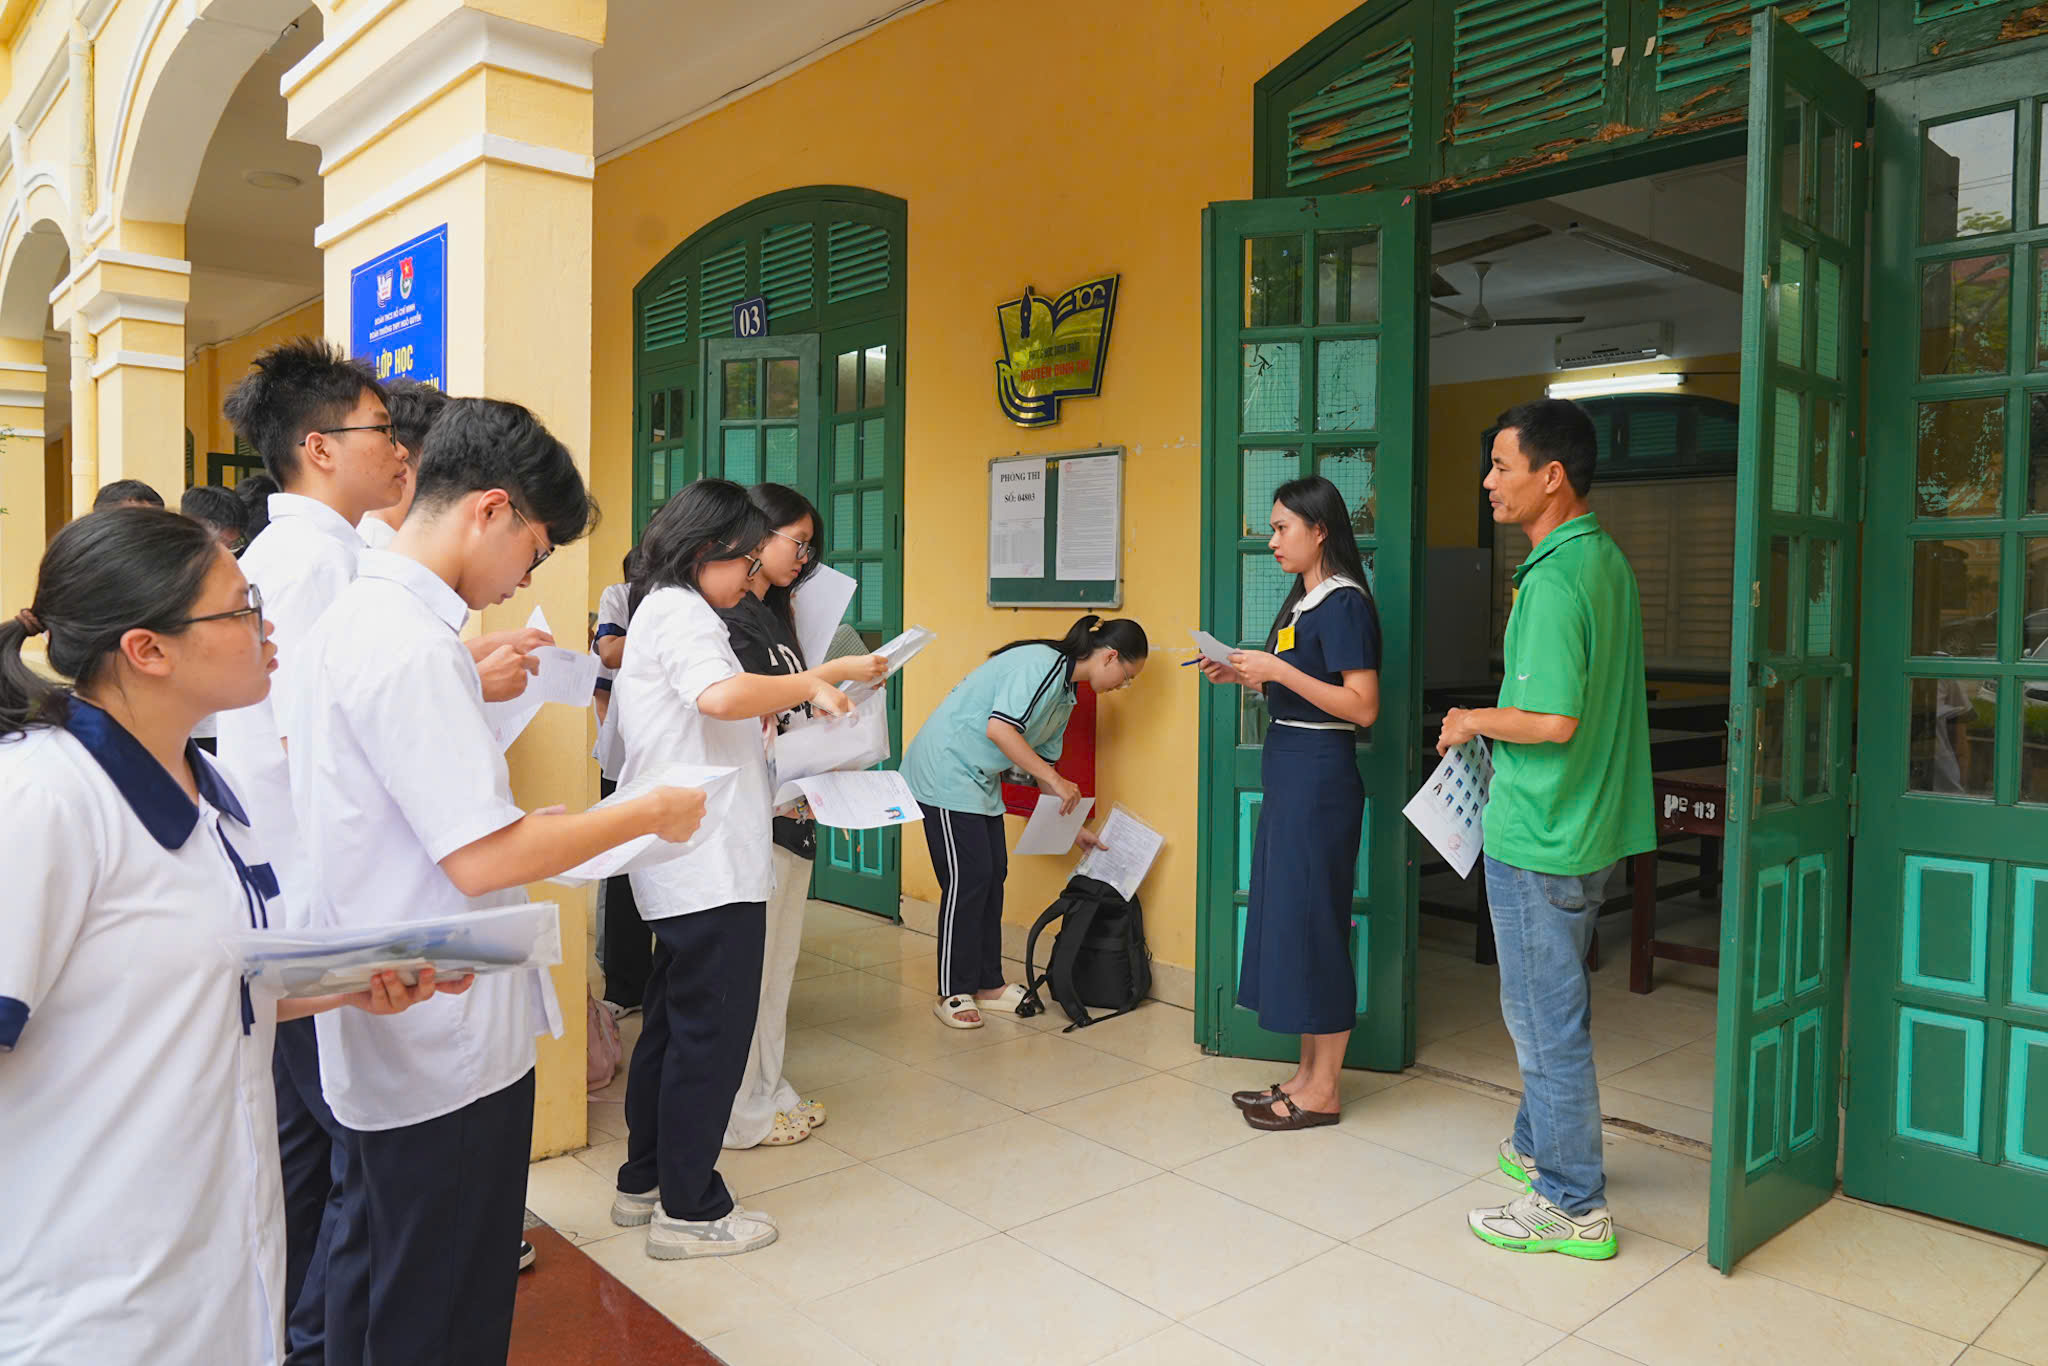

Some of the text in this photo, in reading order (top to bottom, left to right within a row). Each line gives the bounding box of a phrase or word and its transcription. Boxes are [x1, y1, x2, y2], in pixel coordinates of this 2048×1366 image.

[739, 305, 760, 337] 03
[376, 344, 414, 380] LỚP HỌC
[1000, 471, 1041, 482] PHÒNG THI
